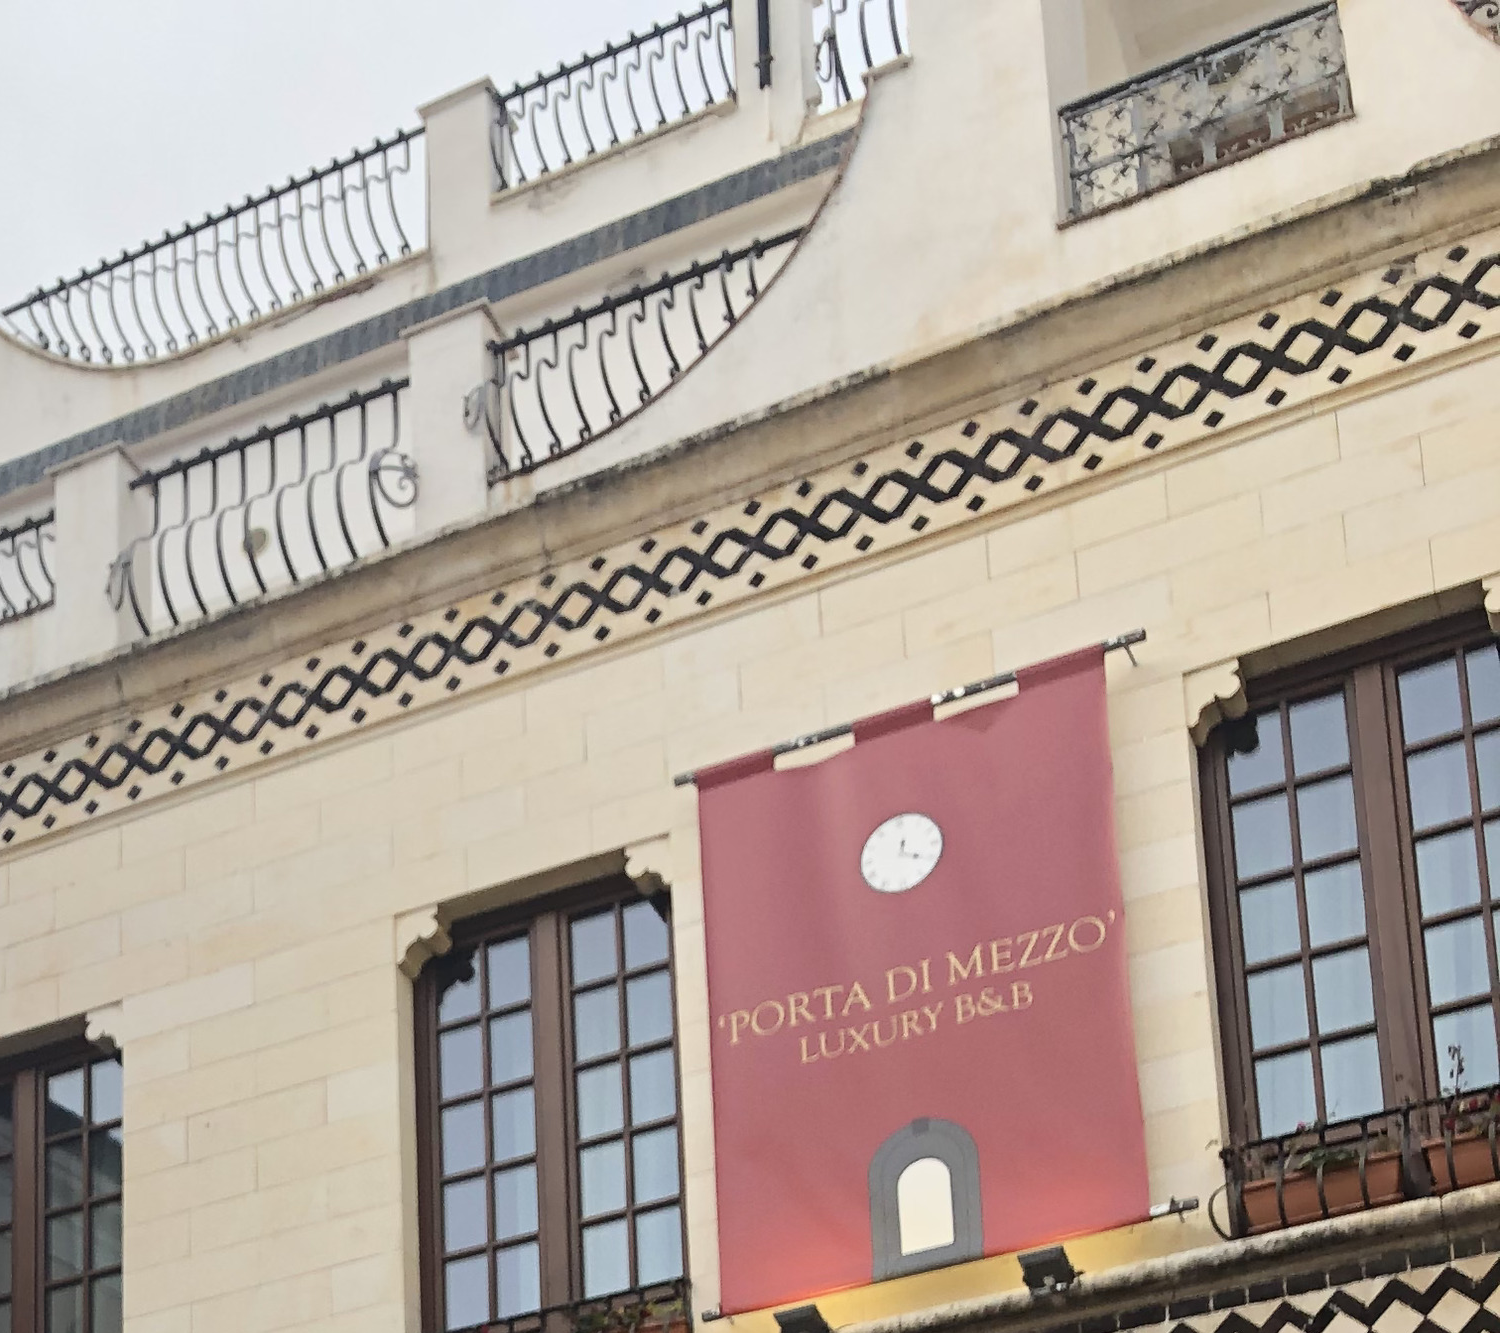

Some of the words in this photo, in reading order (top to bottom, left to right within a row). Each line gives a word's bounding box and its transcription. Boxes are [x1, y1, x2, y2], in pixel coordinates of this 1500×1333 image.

[885, 957, 934, 1004] DI
[799, 1001, 943, 1065] LUXURY
[954, 980, 1034, 1025] B&B
